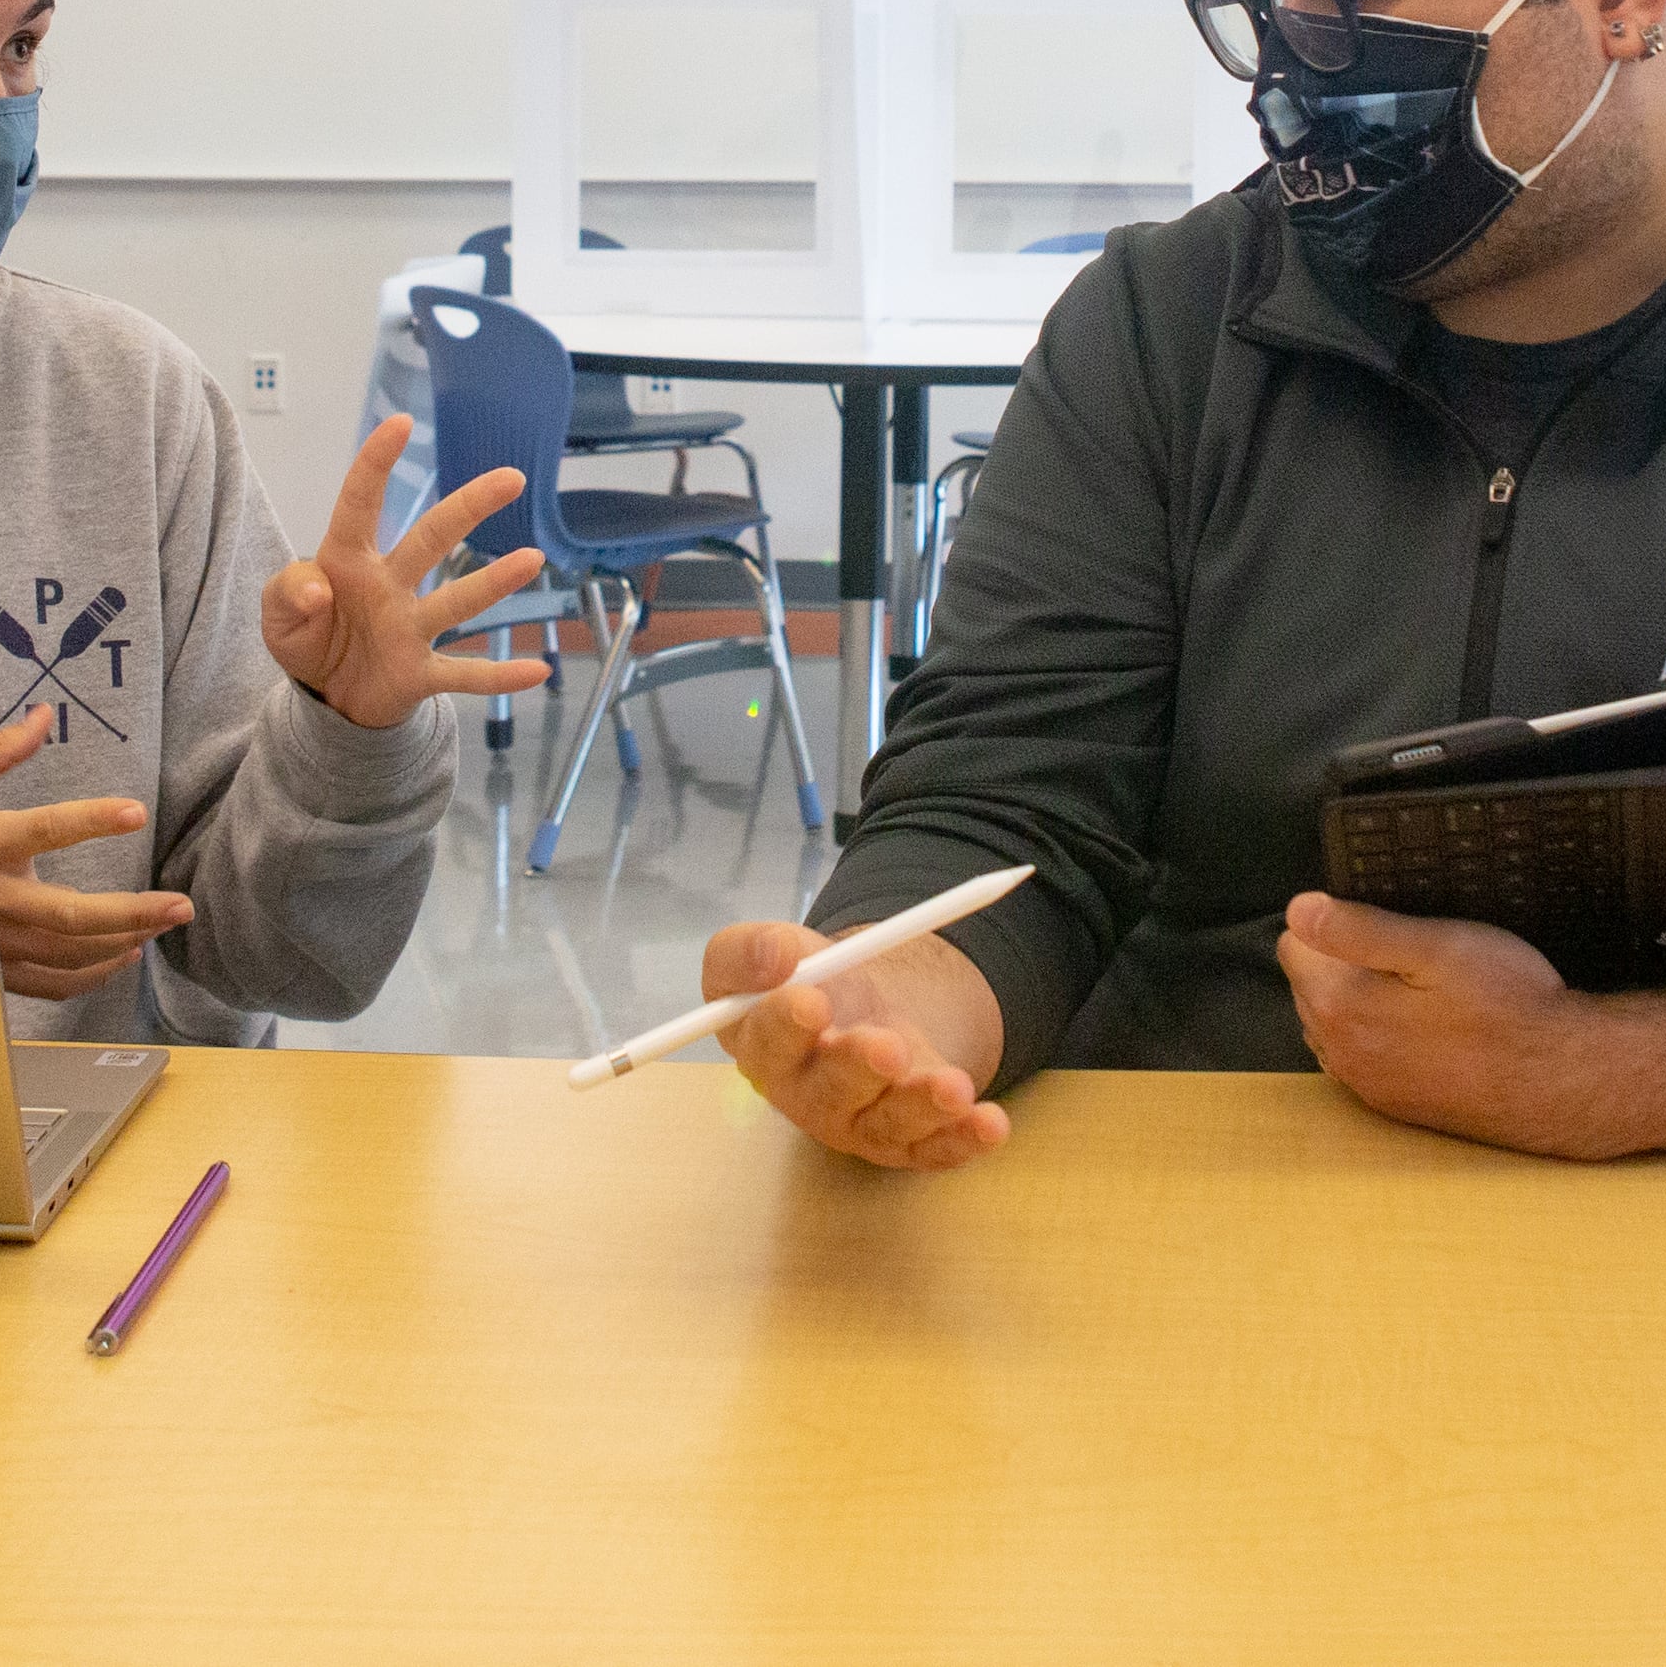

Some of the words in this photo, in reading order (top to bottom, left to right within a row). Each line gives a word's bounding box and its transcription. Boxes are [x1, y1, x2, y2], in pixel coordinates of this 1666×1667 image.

[35, 577, 64, 624] P
[100, 640, 131, 688] T
[25, 702, 69, 744] I
